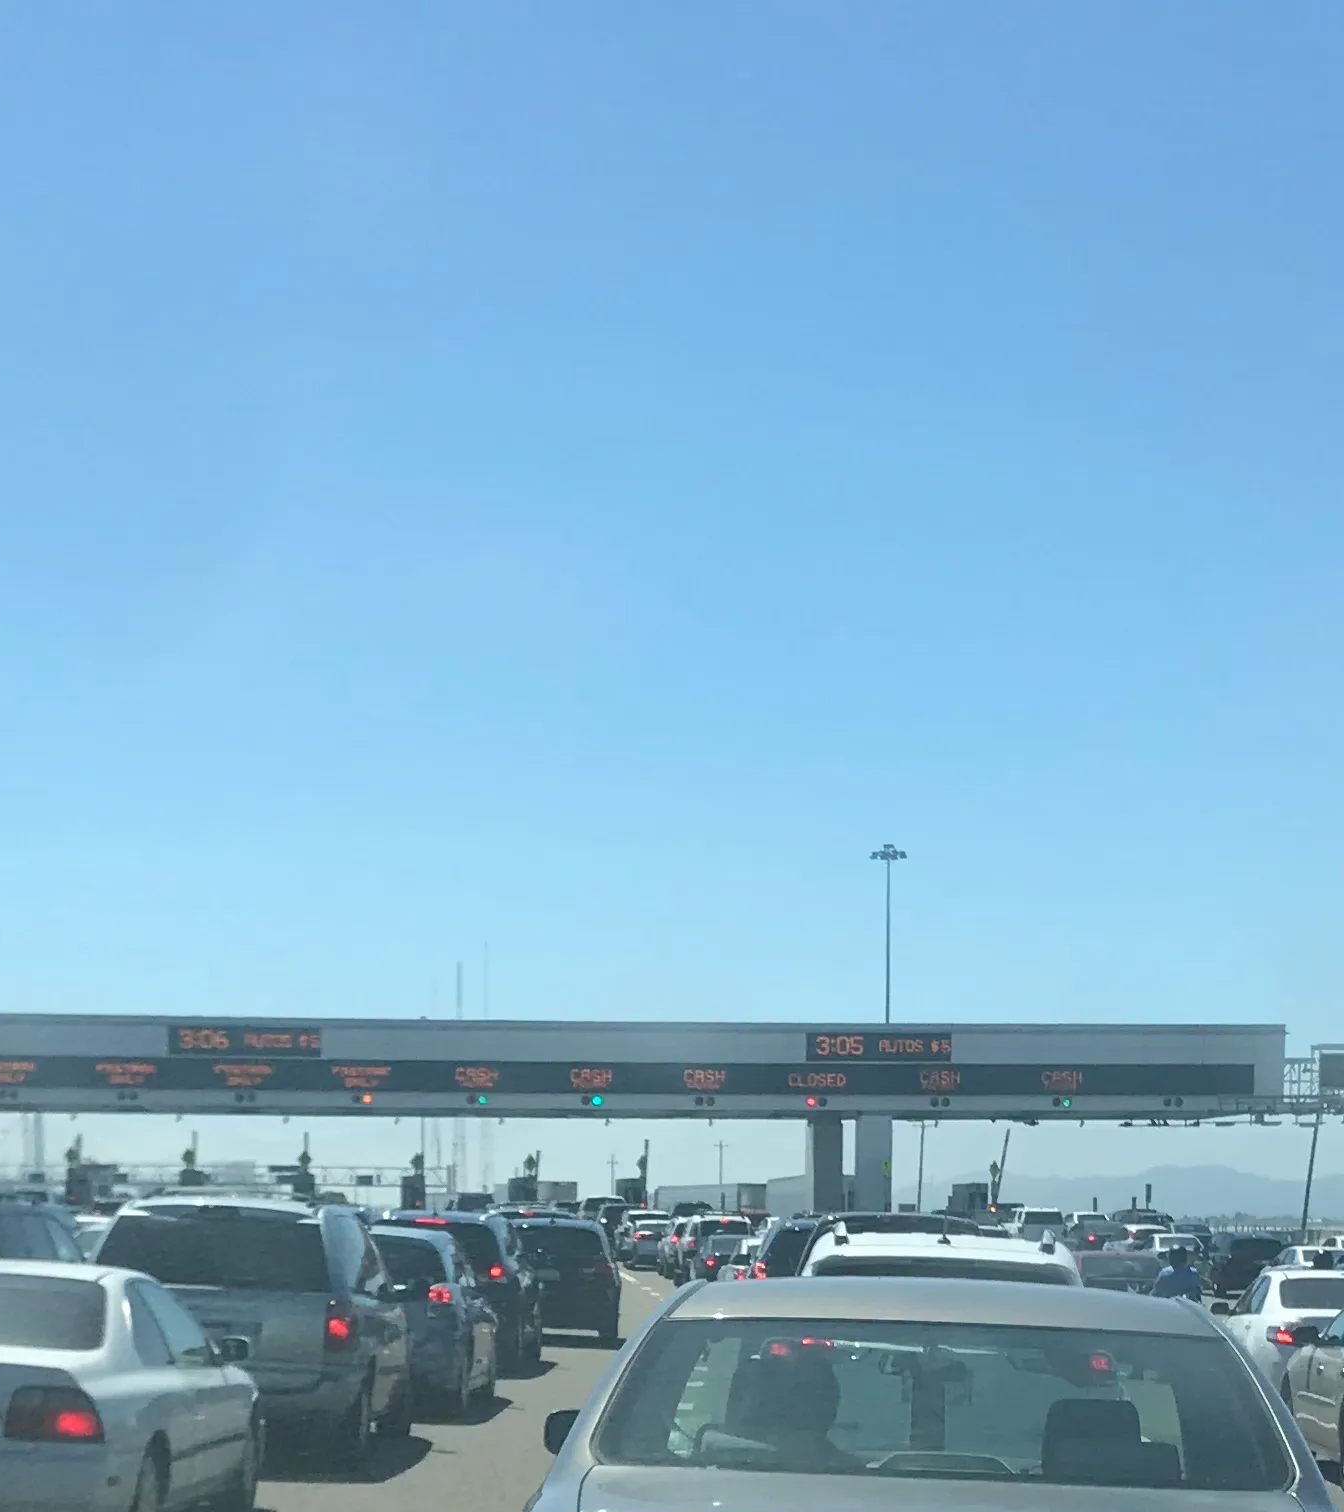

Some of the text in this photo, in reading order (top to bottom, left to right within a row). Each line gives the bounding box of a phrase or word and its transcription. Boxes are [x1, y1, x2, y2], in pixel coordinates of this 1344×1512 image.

[815, 1036, 865, 1056] 3:05
[878, 1039, 924, 1053] AUTOS
[569, 1069, 613, 1082] CASH
[683, 1069, 728, 1083] CASH
[788, 1073, 847, 1088] CLOSED
[919, 1071, 961, 1085] CASH
[1041, 1071, 1083, 1085] CASH
